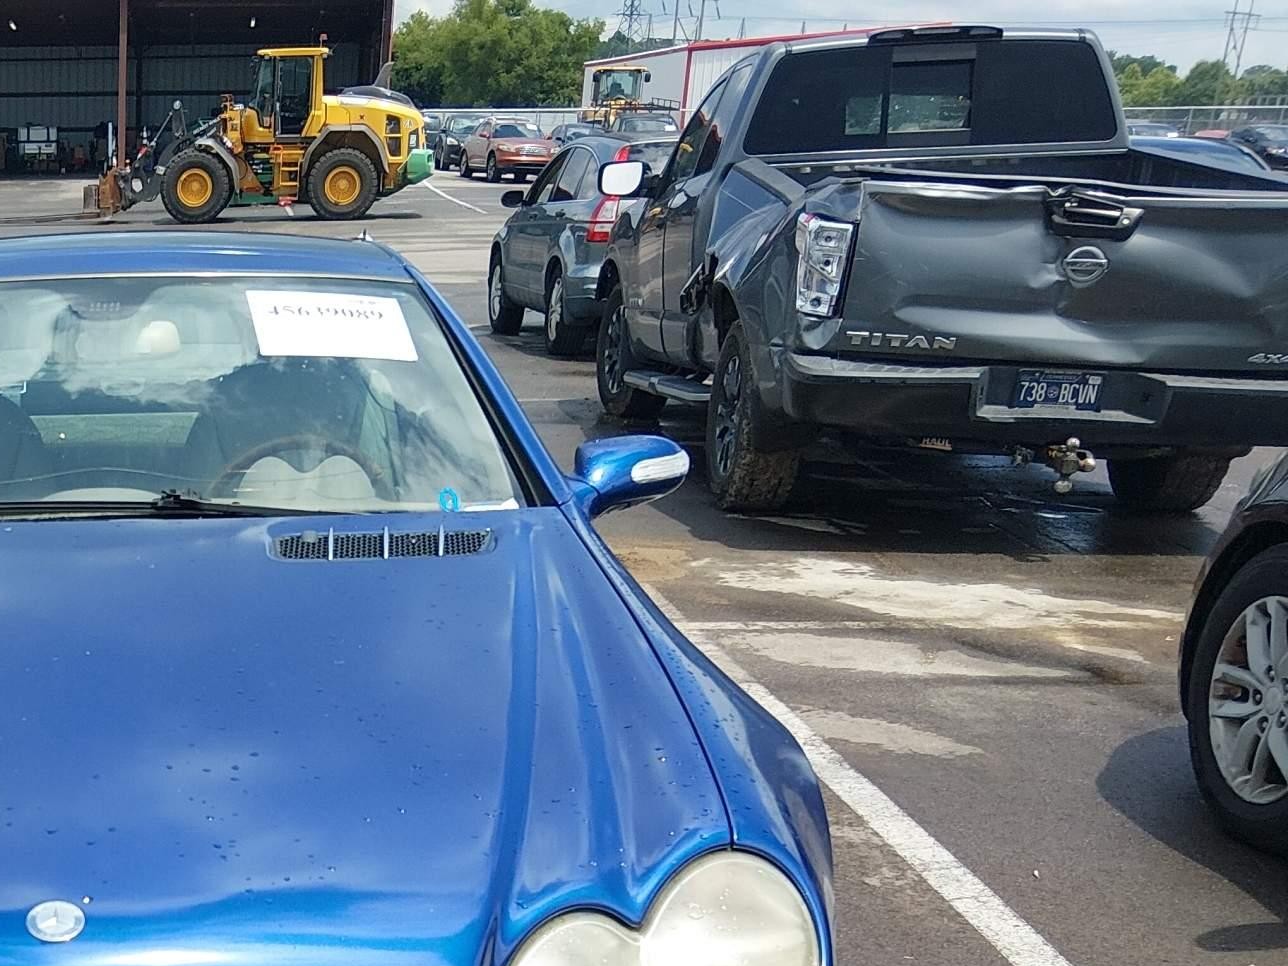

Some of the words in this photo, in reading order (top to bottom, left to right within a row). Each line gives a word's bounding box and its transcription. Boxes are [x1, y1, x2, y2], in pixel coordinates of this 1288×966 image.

[846, 331, 957, 350] TITAN
[1019, 381, 1047, 402] 738
[1058, 383, 1099, 404] BCVN
